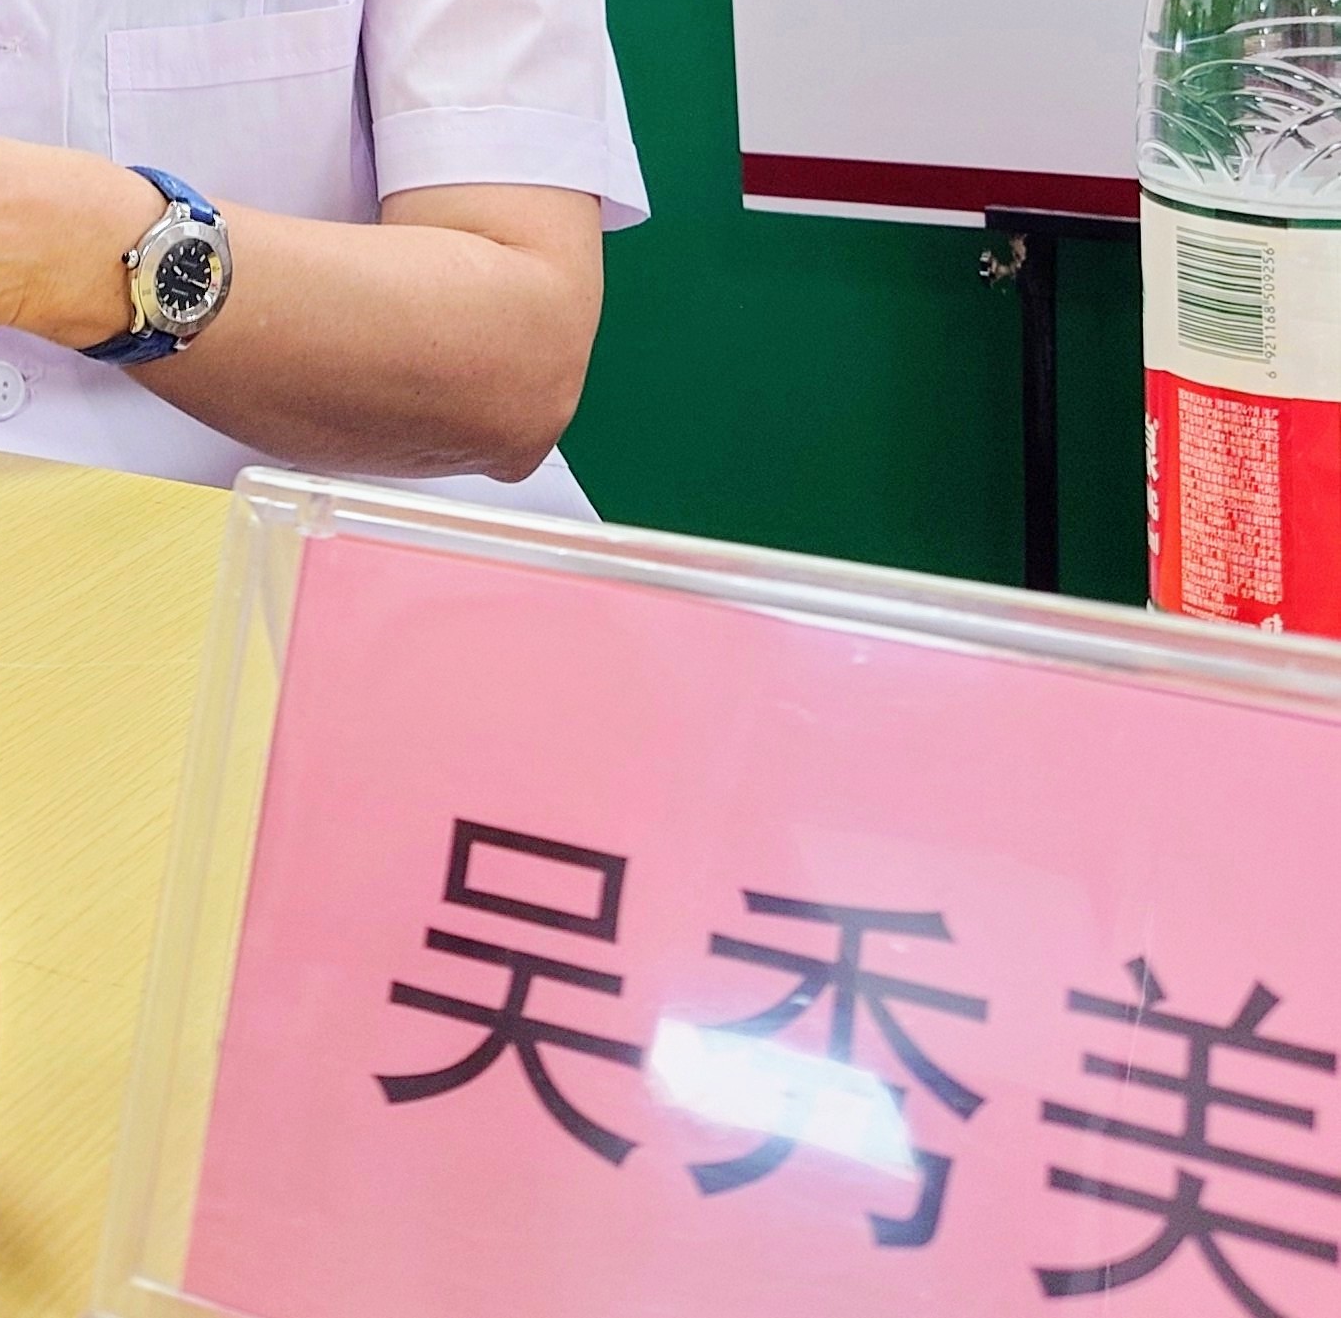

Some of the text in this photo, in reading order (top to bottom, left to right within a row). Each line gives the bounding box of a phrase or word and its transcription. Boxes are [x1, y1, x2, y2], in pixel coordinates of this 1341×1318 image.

[1263, 247, 1275, 300] 509256
[1264, 306, 1276, 359] 921168
[374, 817, 1341, 1318] 吴秀美
